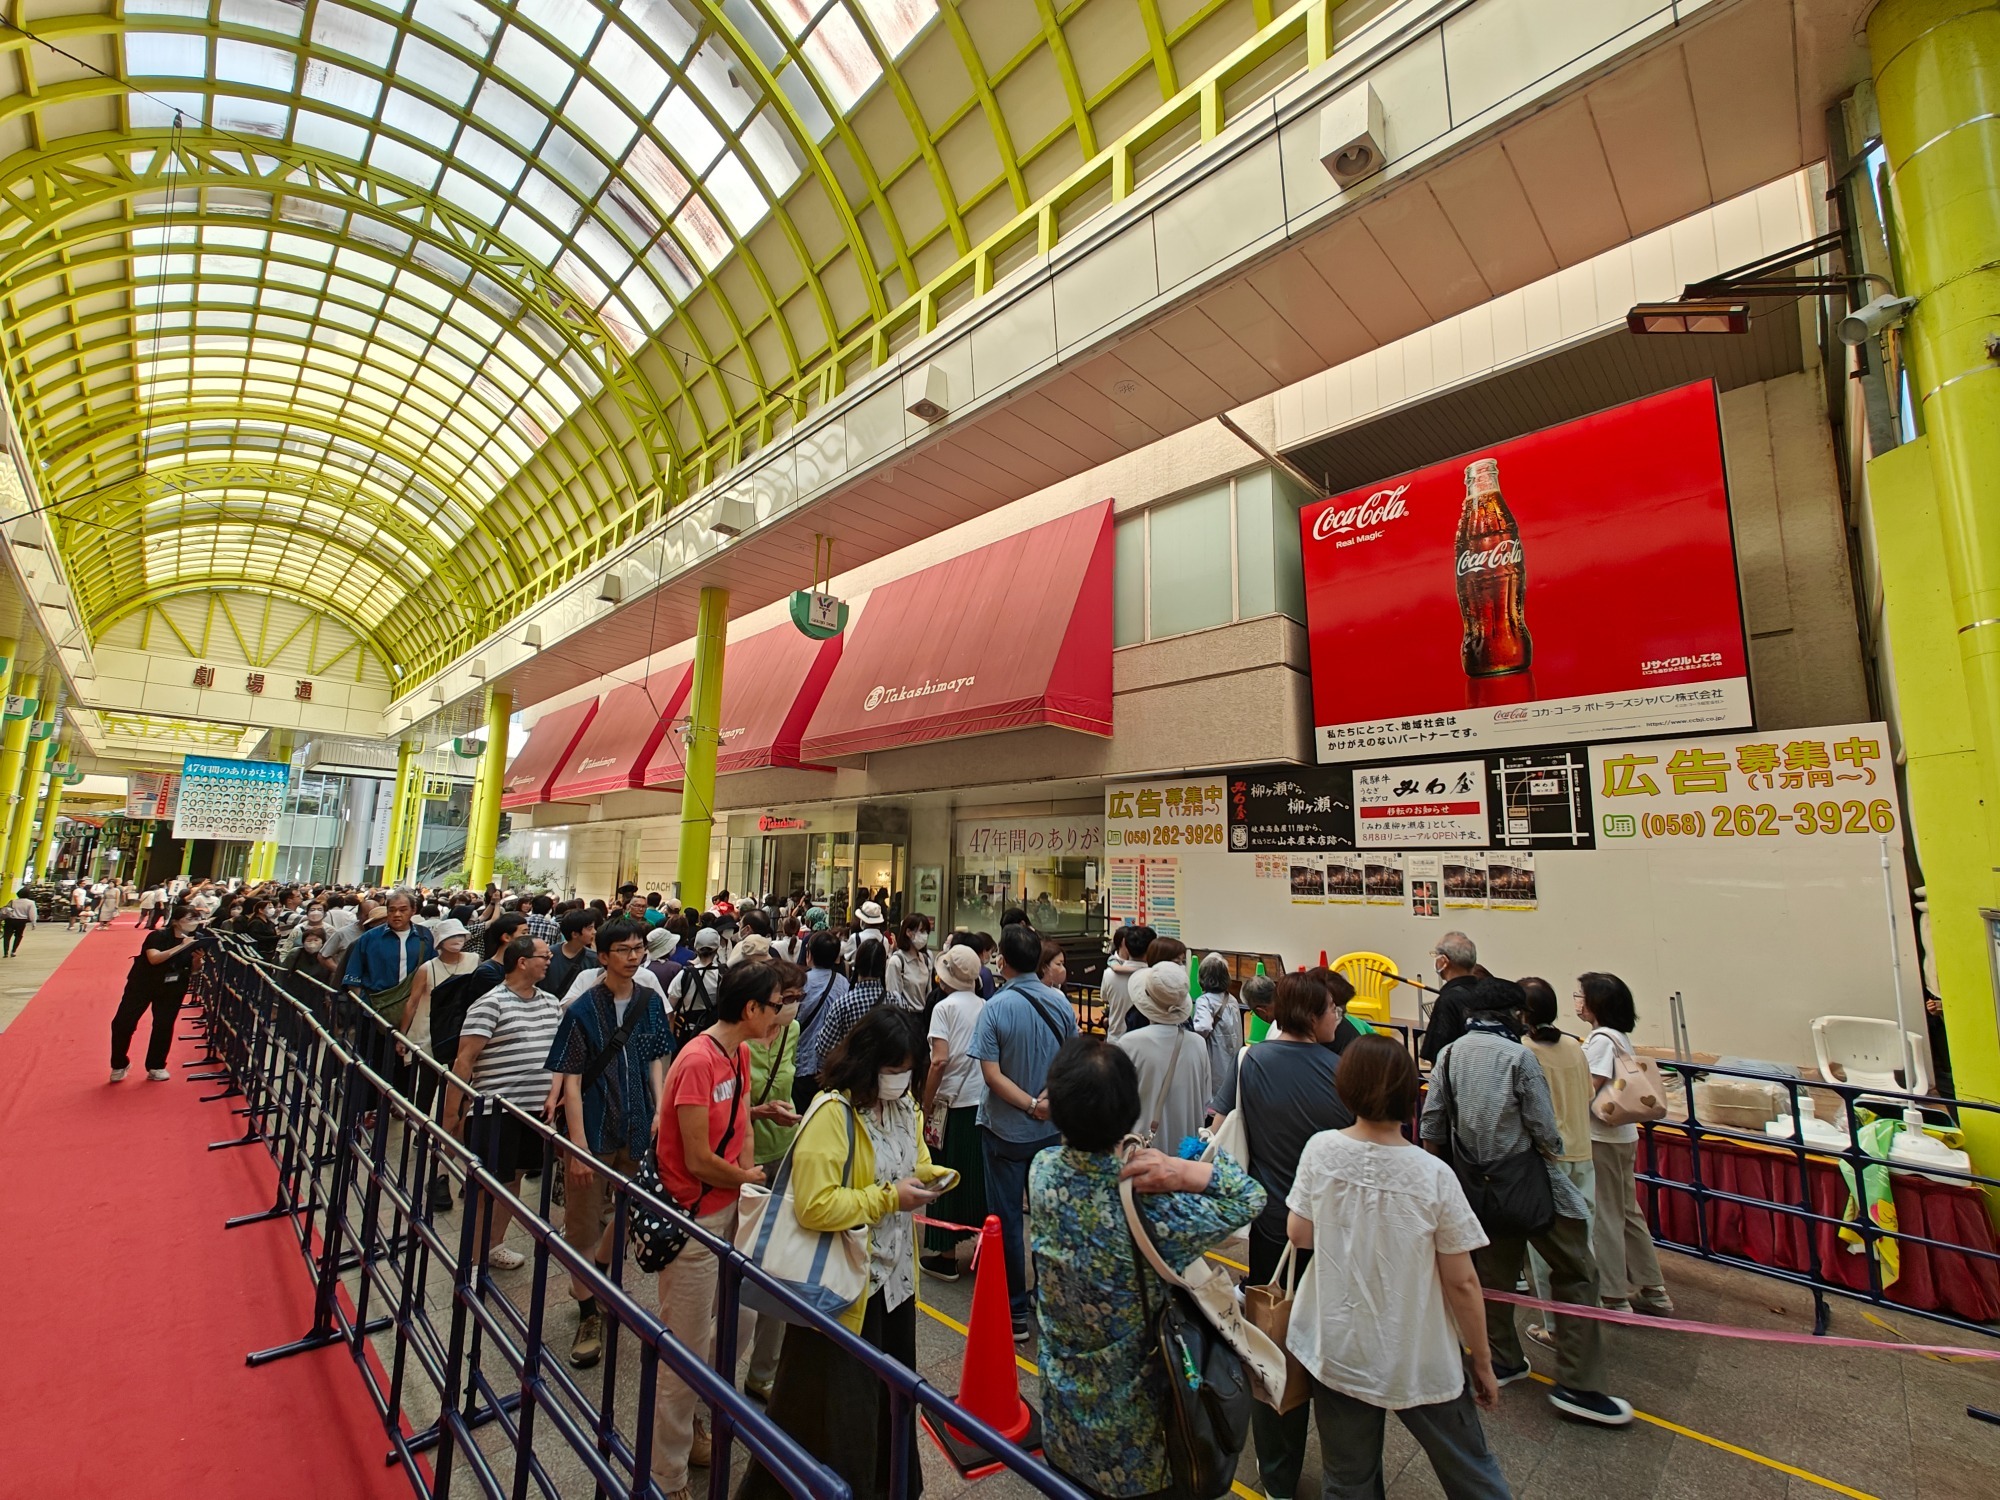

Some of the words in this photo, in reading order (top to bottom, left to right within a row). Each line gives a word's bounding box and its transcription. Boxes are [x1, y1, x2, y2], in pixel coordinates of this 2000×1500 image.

[1336, 537, 1355, 549] Real
[1356, 530, 1384, 544] Magic
[1457, 538, 1522, 576] Coca-Cola
[1641, 652, 1722, 671] リサイクルしてね
[193, 666, 313, 700] 劇場通
[884, 675, 976, 704] Takashimaya
[1327, 716, 1457, 739] 私たちにとって、地域社会は
[1327, 727, 1478, 751] かけがえのないパートナーです。
[1359, 773, 1391, 786] 飛騨牛
[1360, 787, 1380, 795] うなぎ
[1360, 795, 1389, 803] 本マグロ
[1386, 805, 1451, 816] 移転のお知らせ
[969, 825, 1105, 854] 47年間のありが
[1362, 830, 1482, 842] 8月8日リニューアルOPEN予定。
[645, 881, 671, 892] COACH
